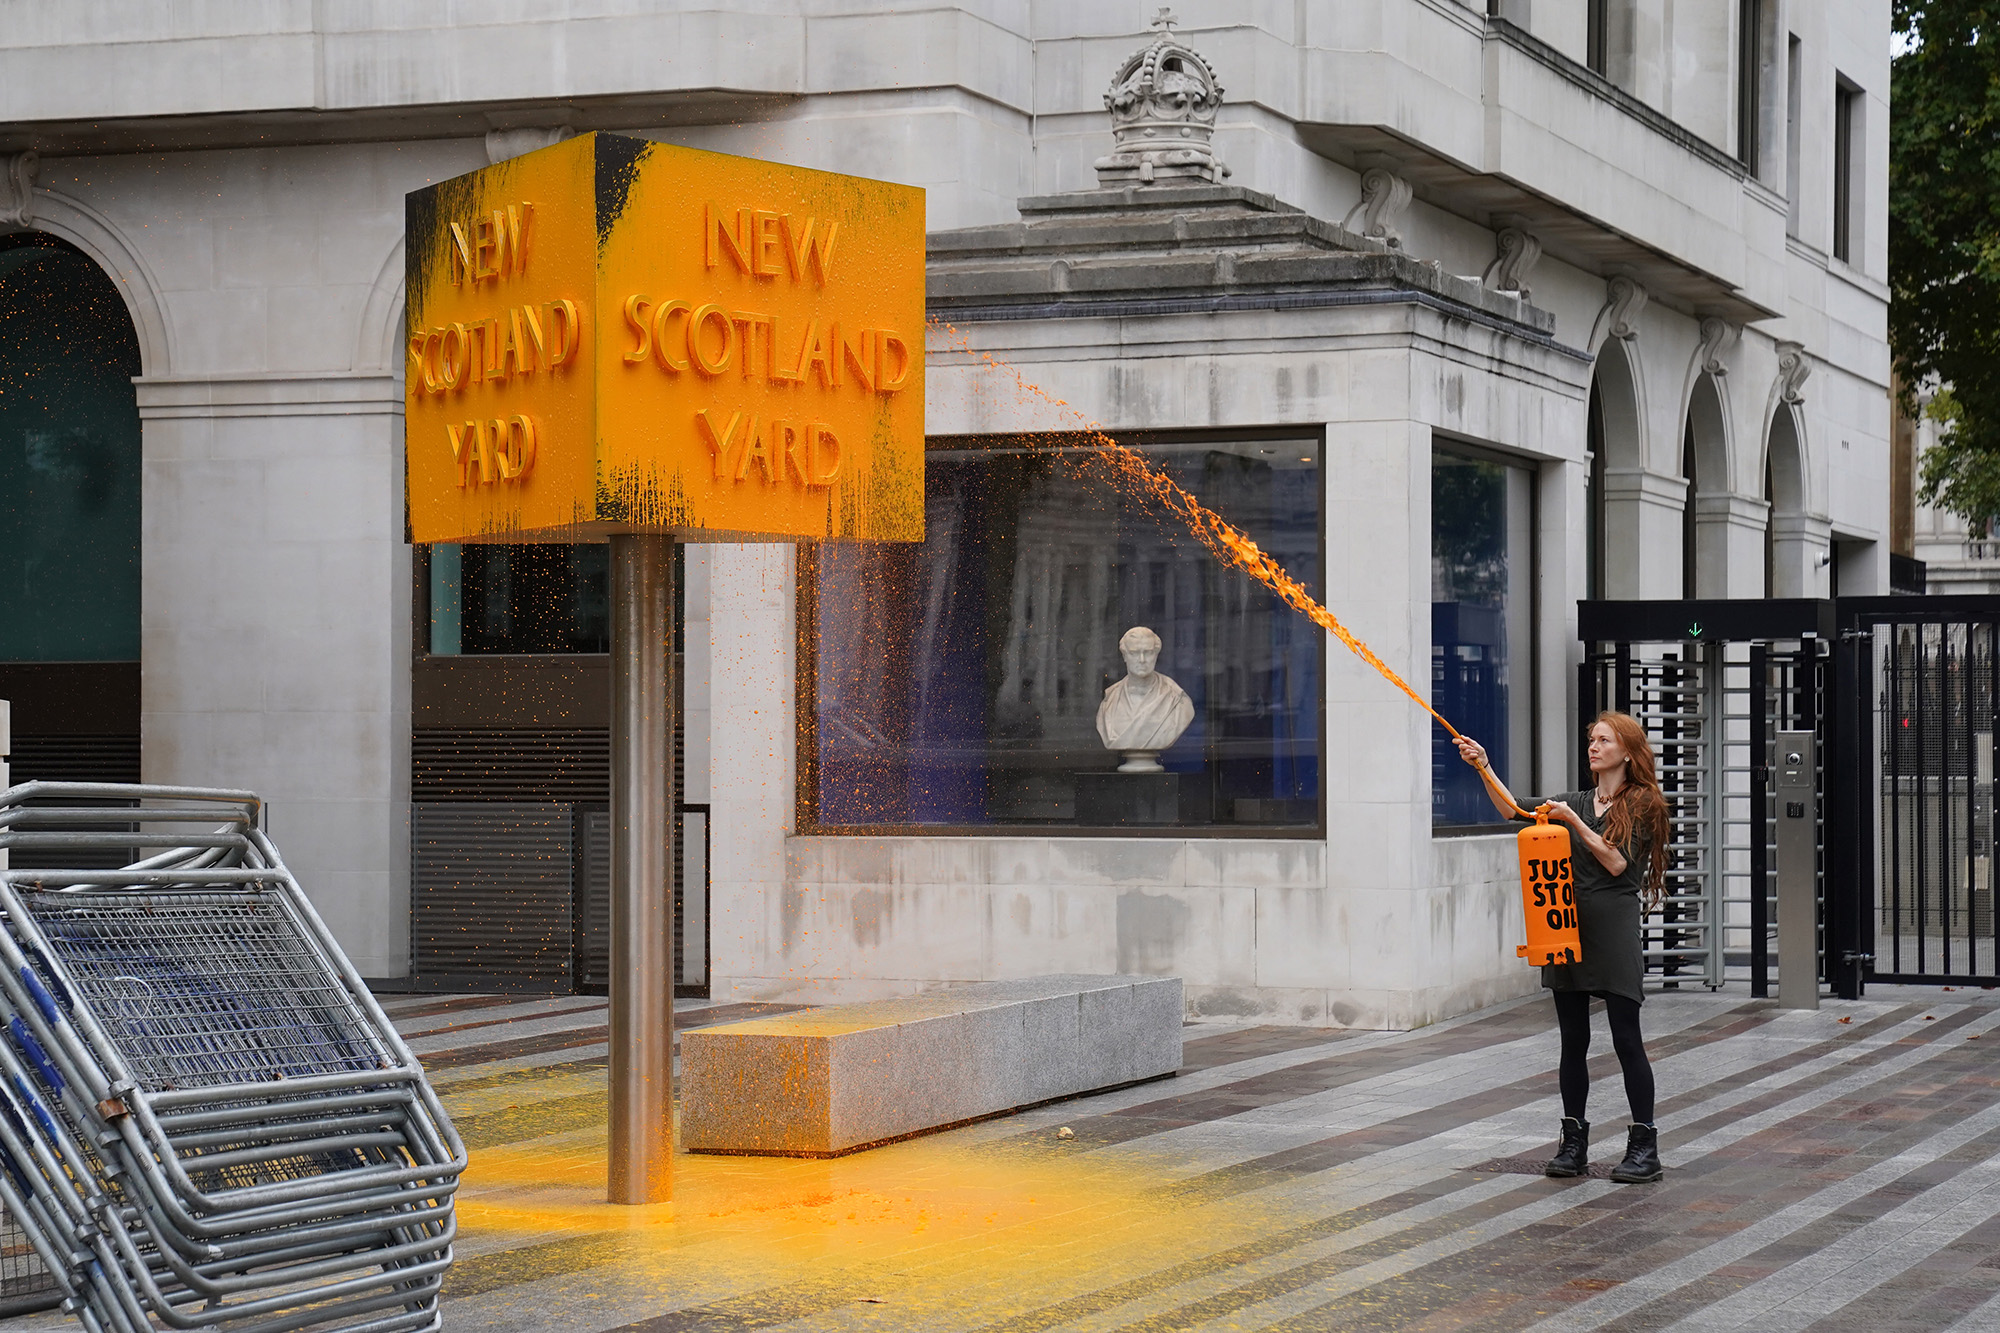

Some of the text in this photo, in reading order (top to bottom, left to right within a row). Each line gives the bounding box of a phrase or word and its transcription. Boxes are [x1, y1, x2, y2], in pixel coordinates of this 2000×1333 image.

[450, 201, 533, 286] NEW
[705, 203, 840, 288] NEW
[408, 299, 579, 396] SCOTLAND
[623, 294, 909, 392] SCOTLAND
[446, 414, 537, 487] YARD
[696, 408, 841, 488] YARD
[1528, 856, 1573, 882] JUS
[1547, 908, 1576, 930] OIL
